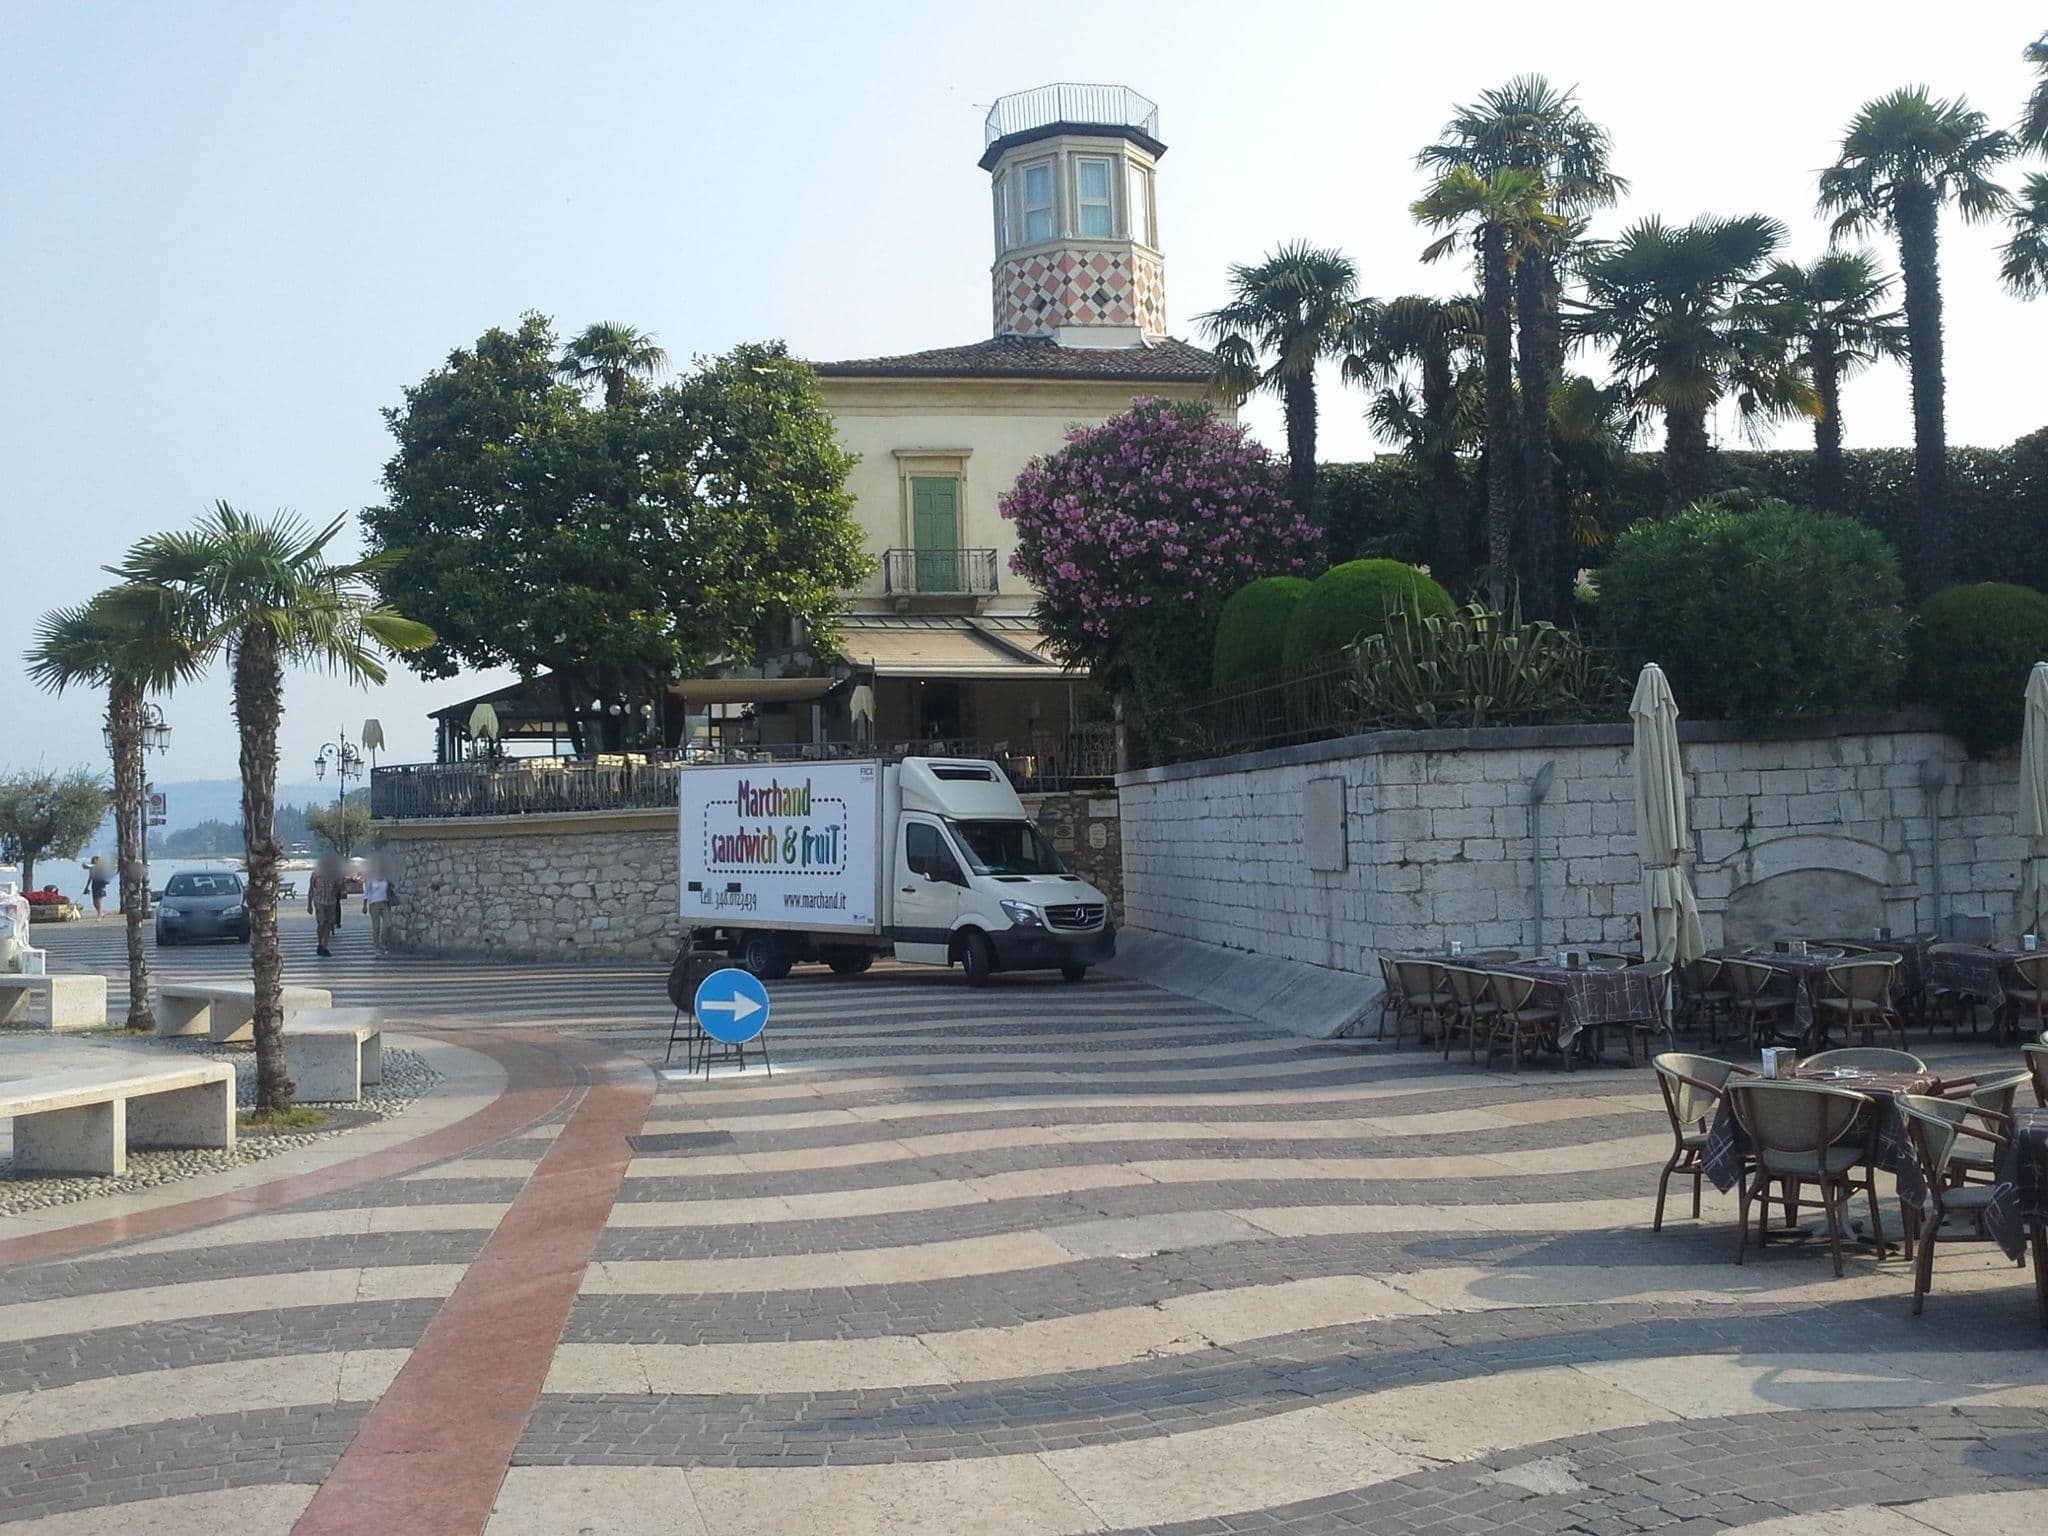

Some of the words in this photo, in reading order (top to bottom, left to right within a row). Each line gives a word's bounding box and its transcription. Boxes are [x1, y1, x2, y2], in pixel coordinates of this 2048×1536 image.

[737, 777, 812, 818] Marchand
[711, 824, 778, 865] sandwich
[782, 824, 798, 865] &
[783, 890, 847, 910] www.marchand.it
